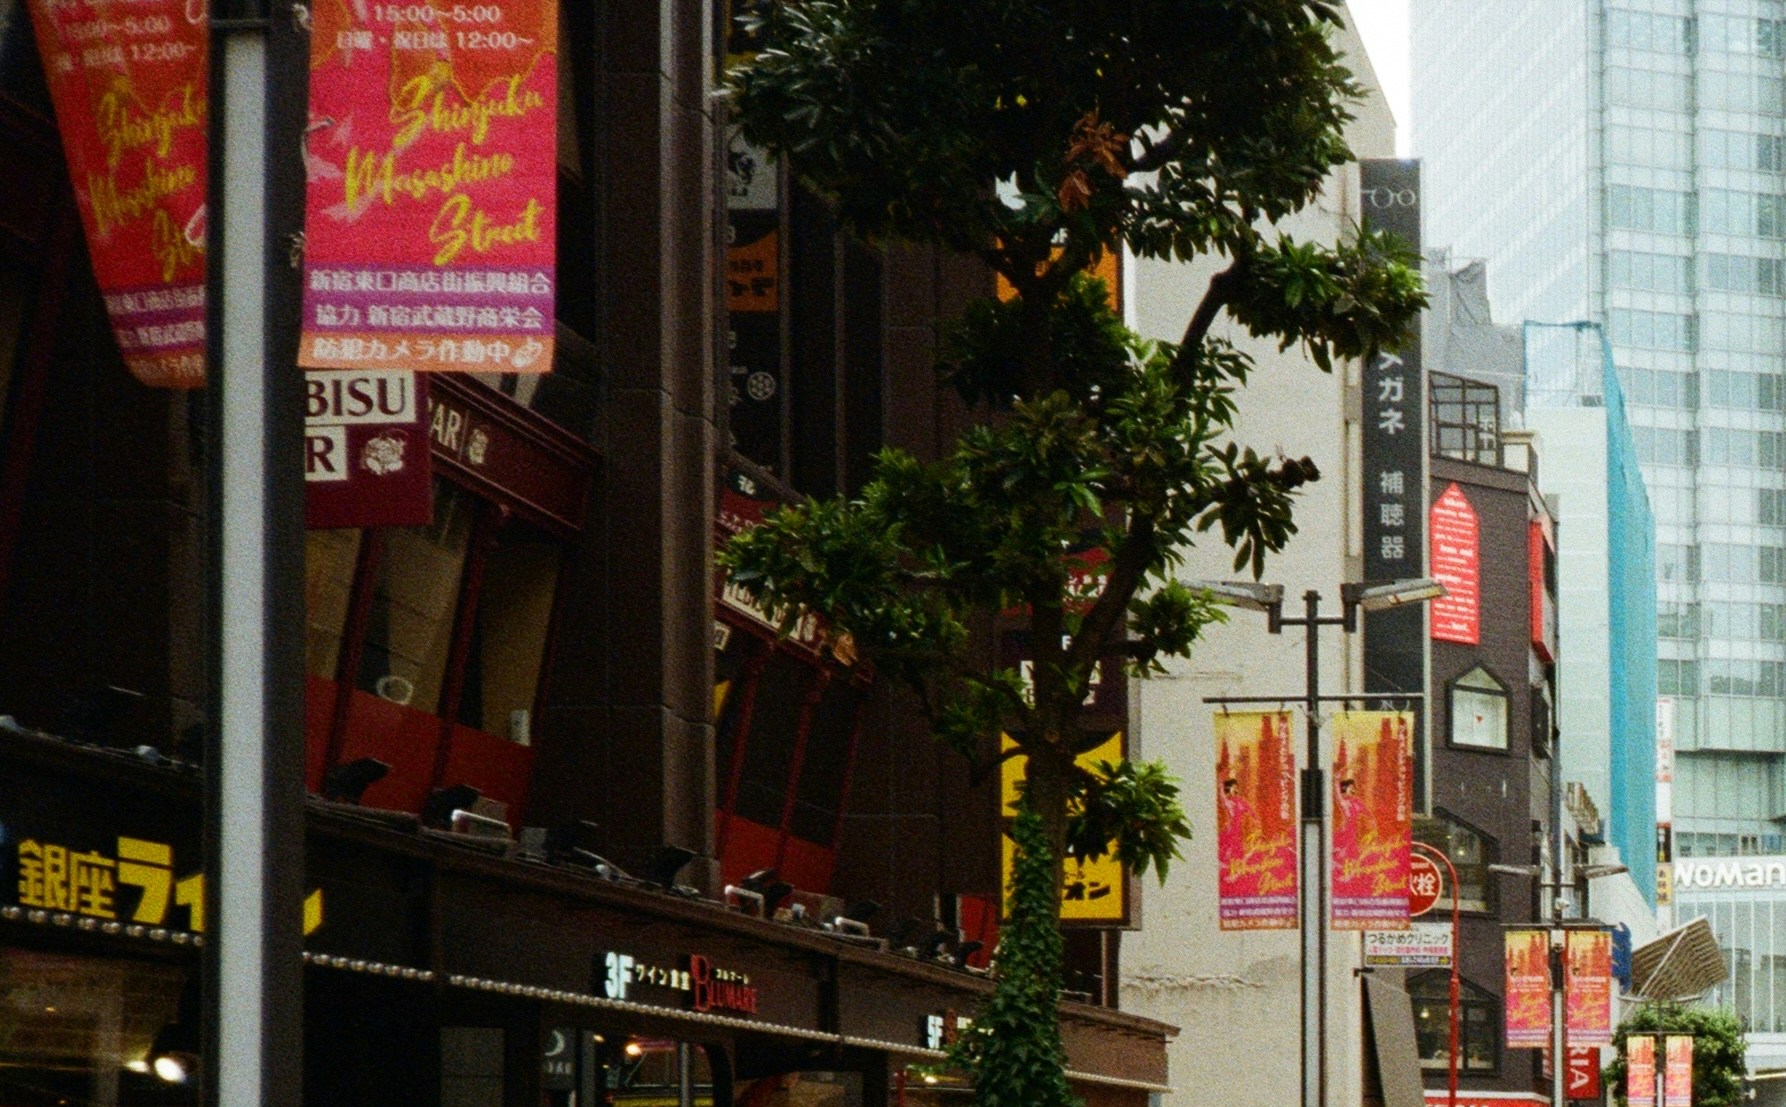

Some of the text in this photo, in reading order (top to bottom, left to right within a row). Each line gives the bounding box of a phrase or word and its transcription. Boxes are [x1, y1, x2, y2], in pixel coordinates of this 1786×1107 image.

[391, 74, 543, 146] Shinjuku
[344, 142, 514, 208] Musashino
[429, 194, 544, 266] Street
[1380, 470, 1405, 560] 補聴器
[1367, 933, 1448, 945] つるかめクリニック
[604, 951, 634, 1000] 3F
